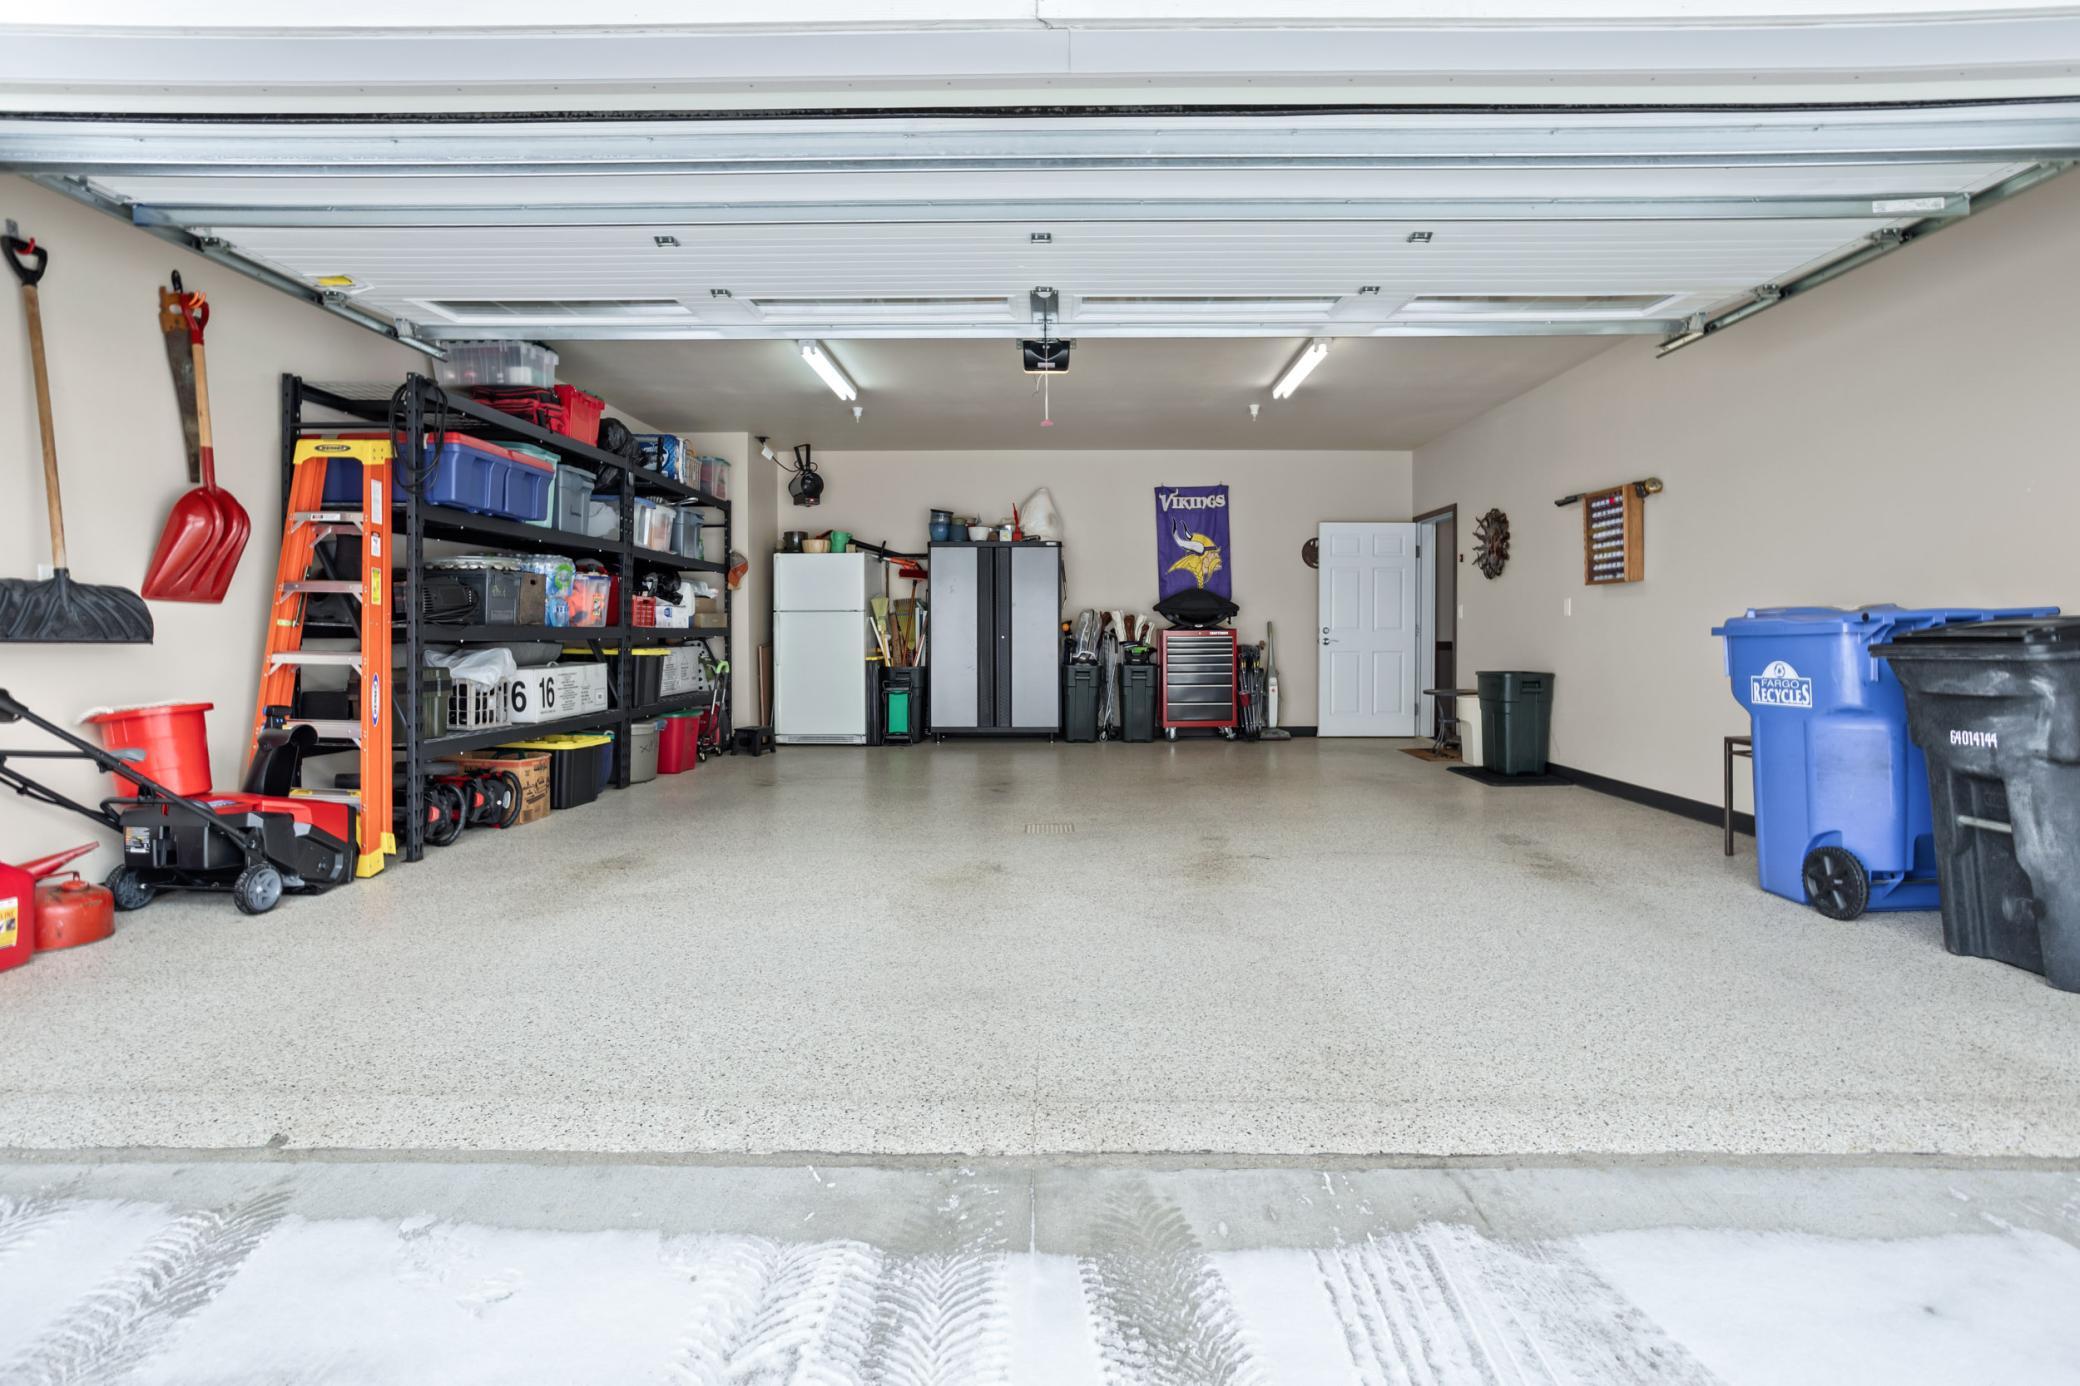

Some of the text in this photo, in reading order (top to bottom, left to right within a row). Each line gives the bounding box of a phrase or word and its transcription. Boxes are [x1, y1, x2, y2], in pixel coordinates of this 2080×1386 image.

[539, 676, 555, 709] 16
[1753, 682, 1810, 705] RECYCLES
[1761, 679, 1800, 689] FARGO
[1950, 729, 1998, 749] 64014144
